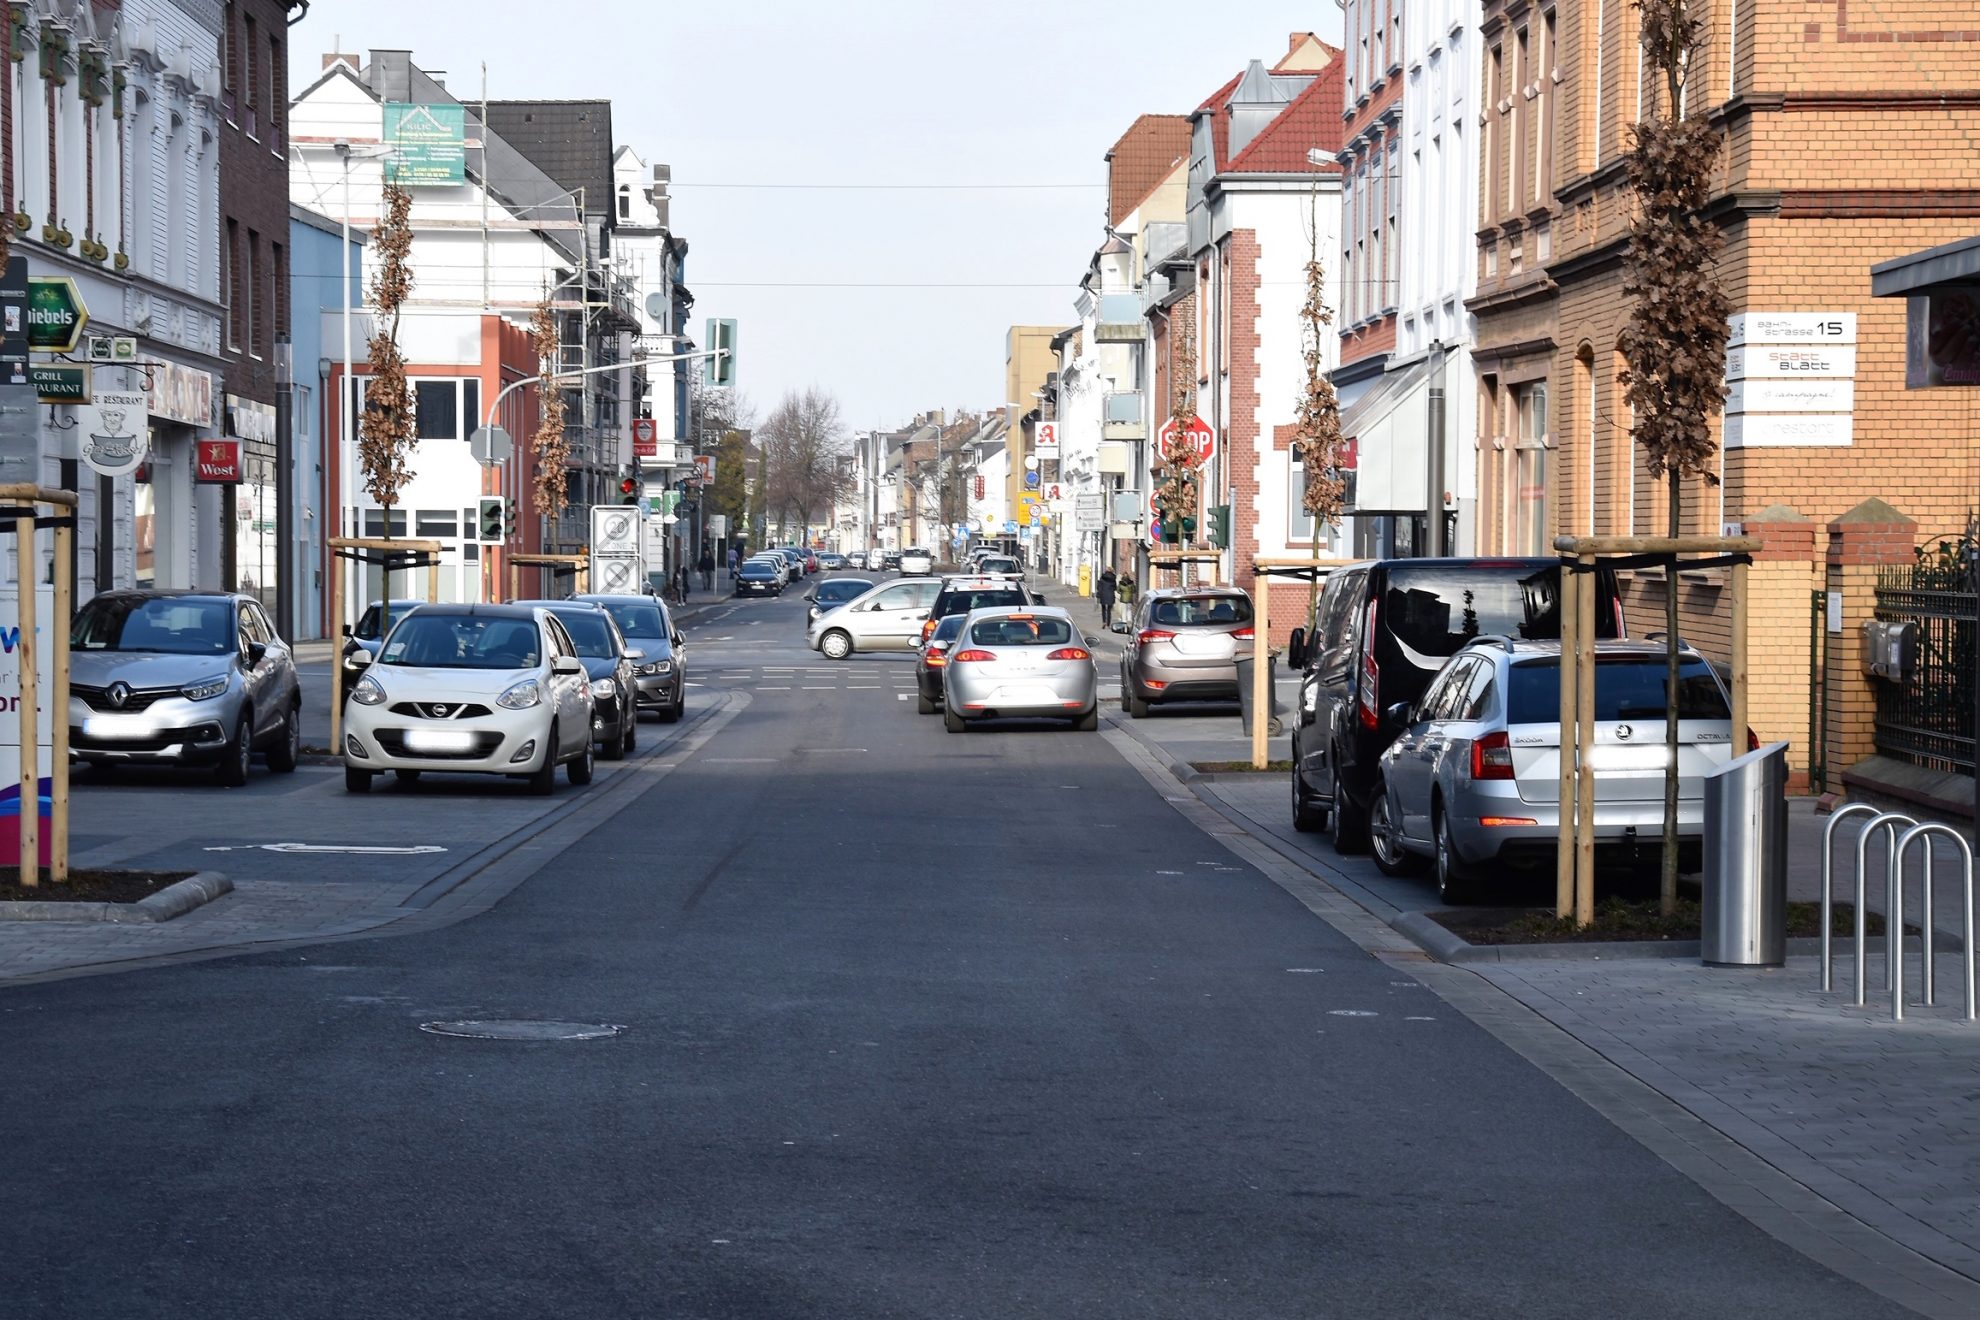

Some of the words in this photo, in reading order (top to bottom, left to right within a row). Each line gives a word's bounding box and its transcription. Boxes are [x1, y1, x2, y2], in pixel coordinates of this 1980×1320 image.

[1817, 321, 1843, 335] 15
[33, 371, 63, 381] GRILL
[1164, 431, 1211, 453] SOP
[200, 463, 236, 476] West
